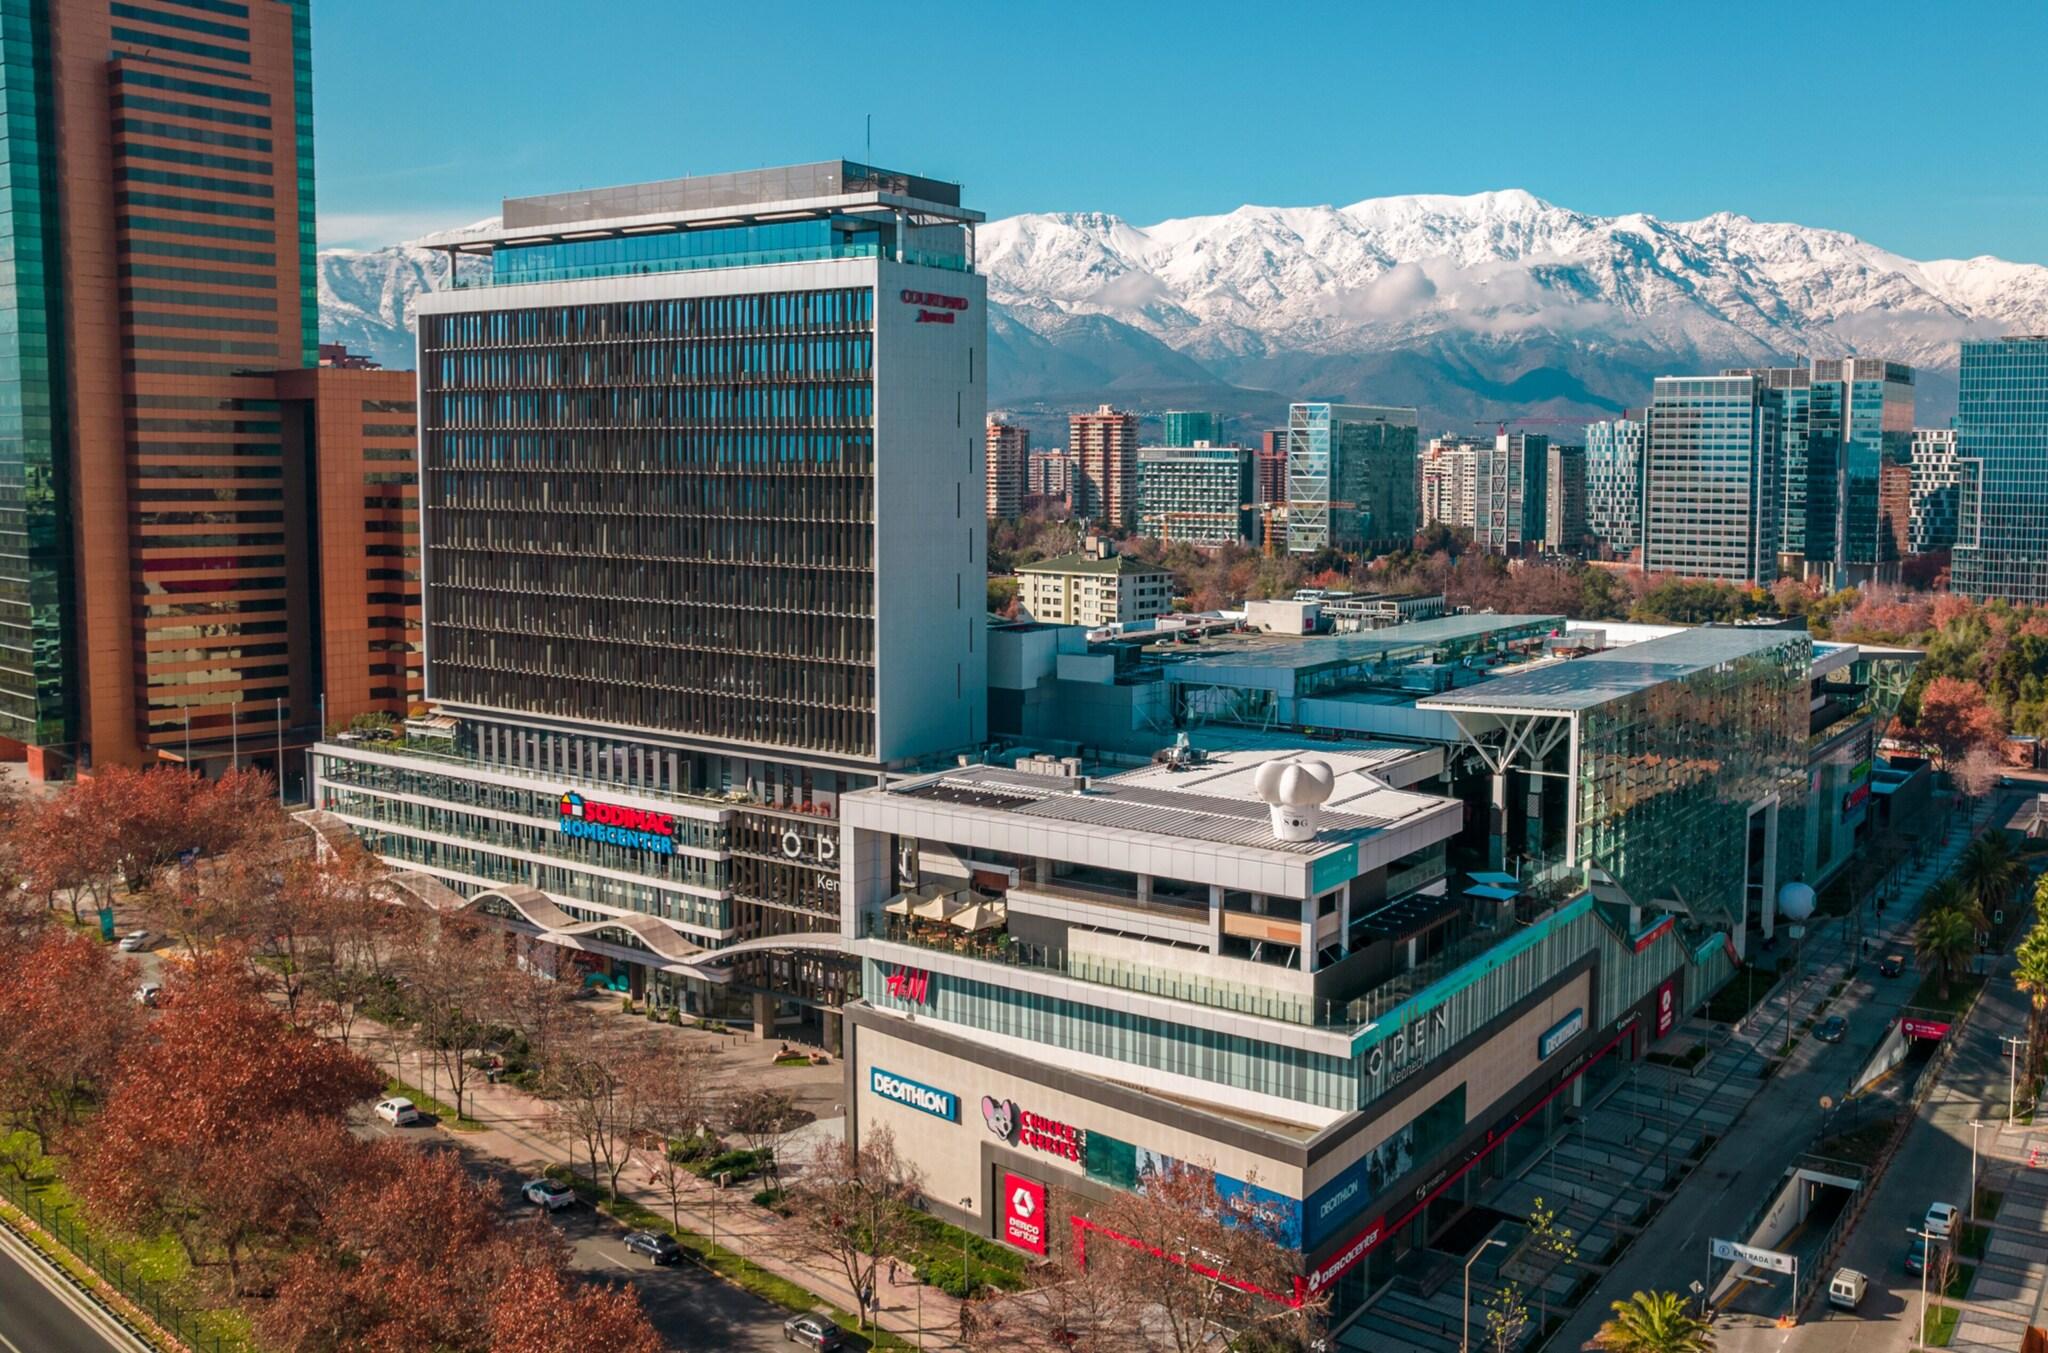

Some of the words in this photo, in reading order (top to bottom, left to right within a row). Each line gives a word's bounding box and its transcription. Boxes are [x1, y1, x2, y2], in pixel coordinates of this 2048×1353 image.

[560, 818, 673, 855] HOMECENTER
[585, 801, 673, 835] SODIMAC
[1369, 1003, 1447, 1076] OPEN
[874, 1073, 947, 1115] DECATHLON
[1020, 1111, 1065, 1139] CHUCK
[1320, 1180, 1359, 1219] DECATHLON
[1733, 1249, 1769, 1264] ENTRADA
